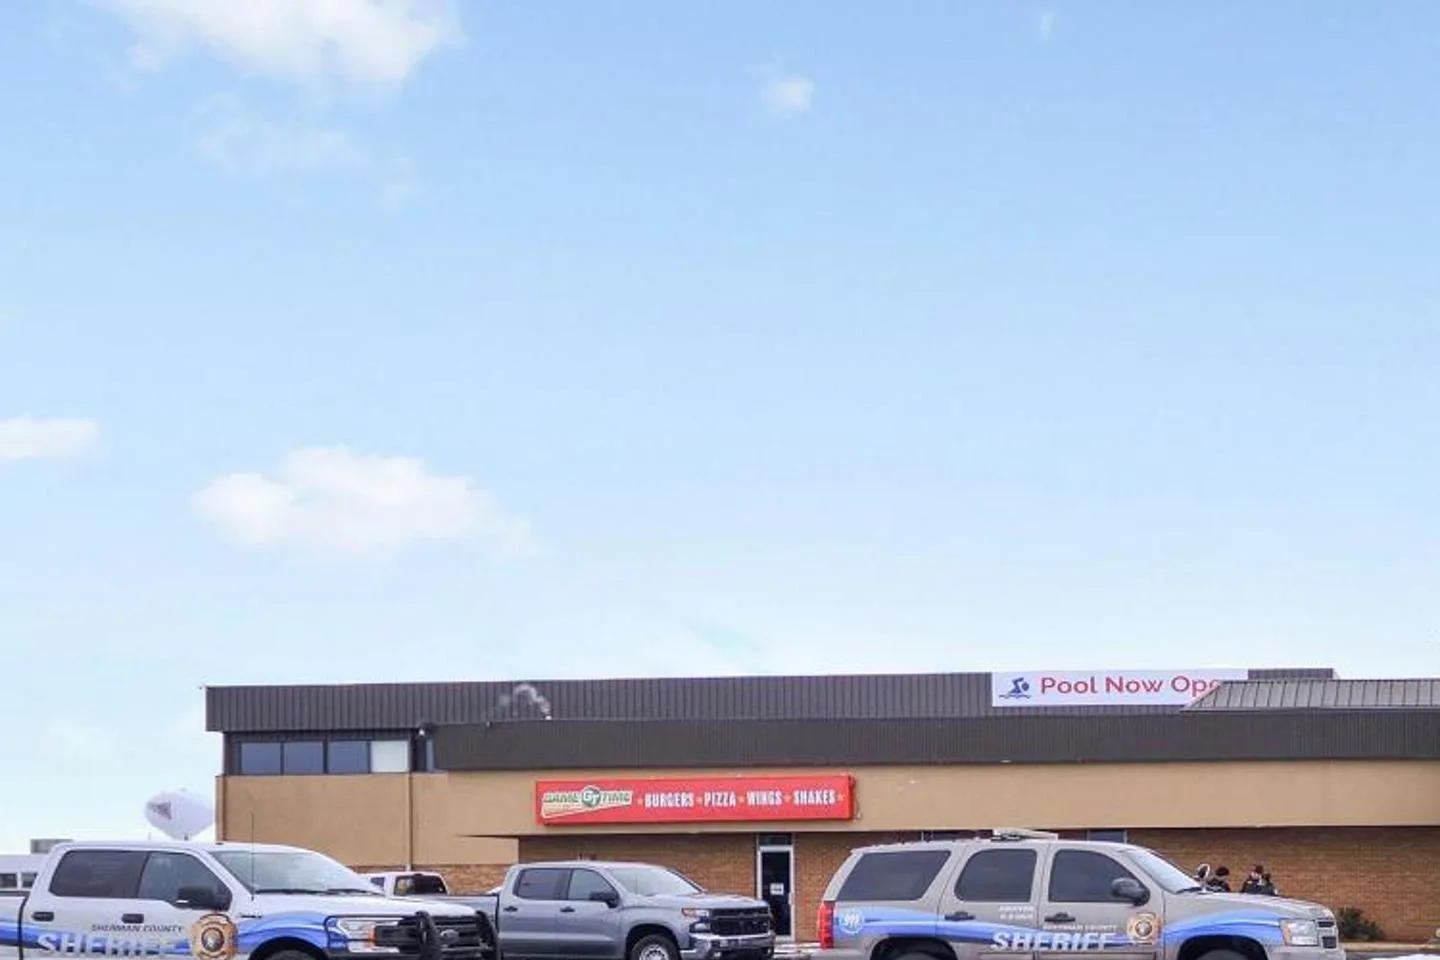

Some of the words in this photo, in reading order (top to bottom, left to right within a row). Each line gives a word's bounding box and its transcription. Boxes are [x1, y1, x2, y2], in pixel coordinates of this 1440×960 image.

[1040, 676, 1098, 694] Pool
[1105, 676, 1163, 693] Now
[1171, 675, 1222, 697] Ope
[644, 792, 694, 808] BURGERS
[704, 791, 736, 806] PIZZA
[747, 791, 782, 806] WINGS
[793, 789, 836, 805] SHAKES
[38, 932, 178, 959] SHERIFF
[991, 931, 1116, 951] SHERIFF
